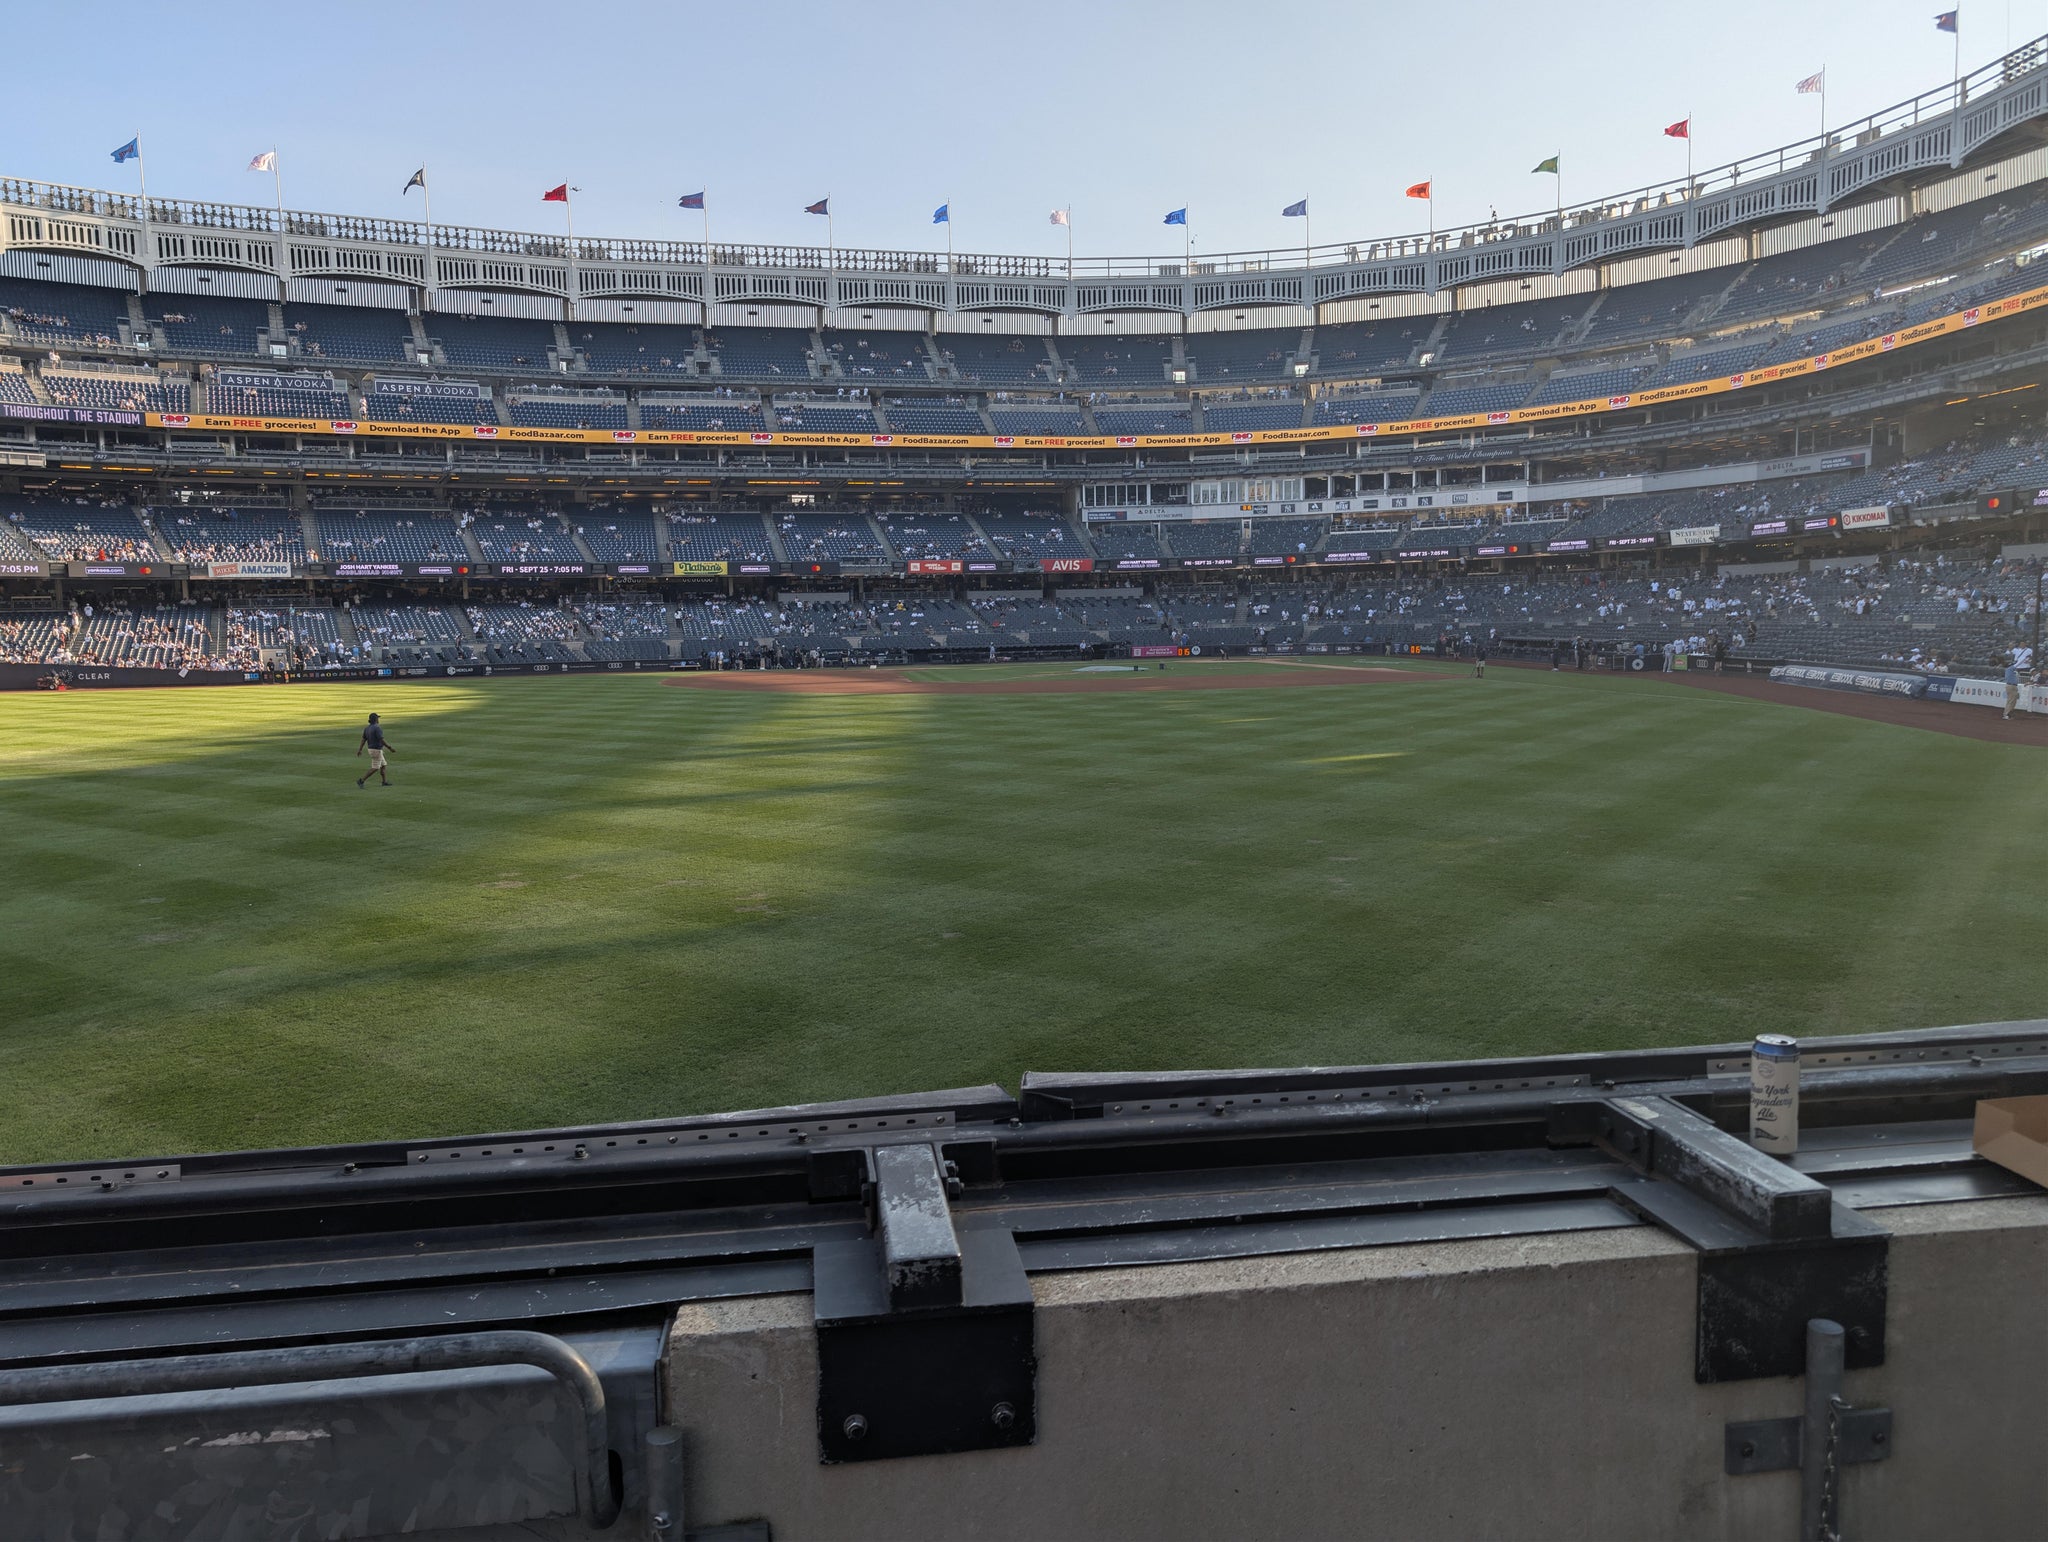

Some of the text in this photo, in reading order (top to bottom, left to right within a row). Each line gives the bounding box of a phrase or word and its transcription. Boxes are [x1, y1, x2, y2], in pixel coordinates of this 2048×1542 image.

[2003, 298, 2020, 310] FREE
[1764, 369, 1778, 379] FREE
[227, 376, 327, 388] ASPEN VODKA
[381, 384, 474, 395] ASPEN VODKA
[1640, 385, 1708, 402] FoodBazaar.com
[3, 404, 140, 424] THROUGHOUT THE STADIUM
[1519, 407, 1560, 418] Download
[1578, 404, 1596, 412] App
[205, 418, 316, 431] Earn FREE groceries!
[1434, 417, 1475, 429] groceries!
[369, 425, 460, 436] Download the App
[510, 430, 584, 439] FoodBazaar.com
[1263, 431, 1330, 439] FoodBazaar.com
[696, 434, 739, 443] groceries!
[843, 436, 860, 444] App
[1066, 439, 1105, 447] groceries!
[1203, 436, 1220, 444] App
[1446, 451, 1470, 461] World
[1472, 449, 1513, 459] Champions
[1852, 512, 1886, 523] KIKKOMAN
[1, 565, 38, 573] 7:05 PM
[241, 566, 288, 574] AMAZING
[679, 563, 722, 574] Nathan's
[1052, 560, 1080, 571] AVIS
[1765, 1084, 1791, 1098] York
[1751, 1096, 1793, 1108] egendary
[1757, 1107, 1777, 1121] Ale
